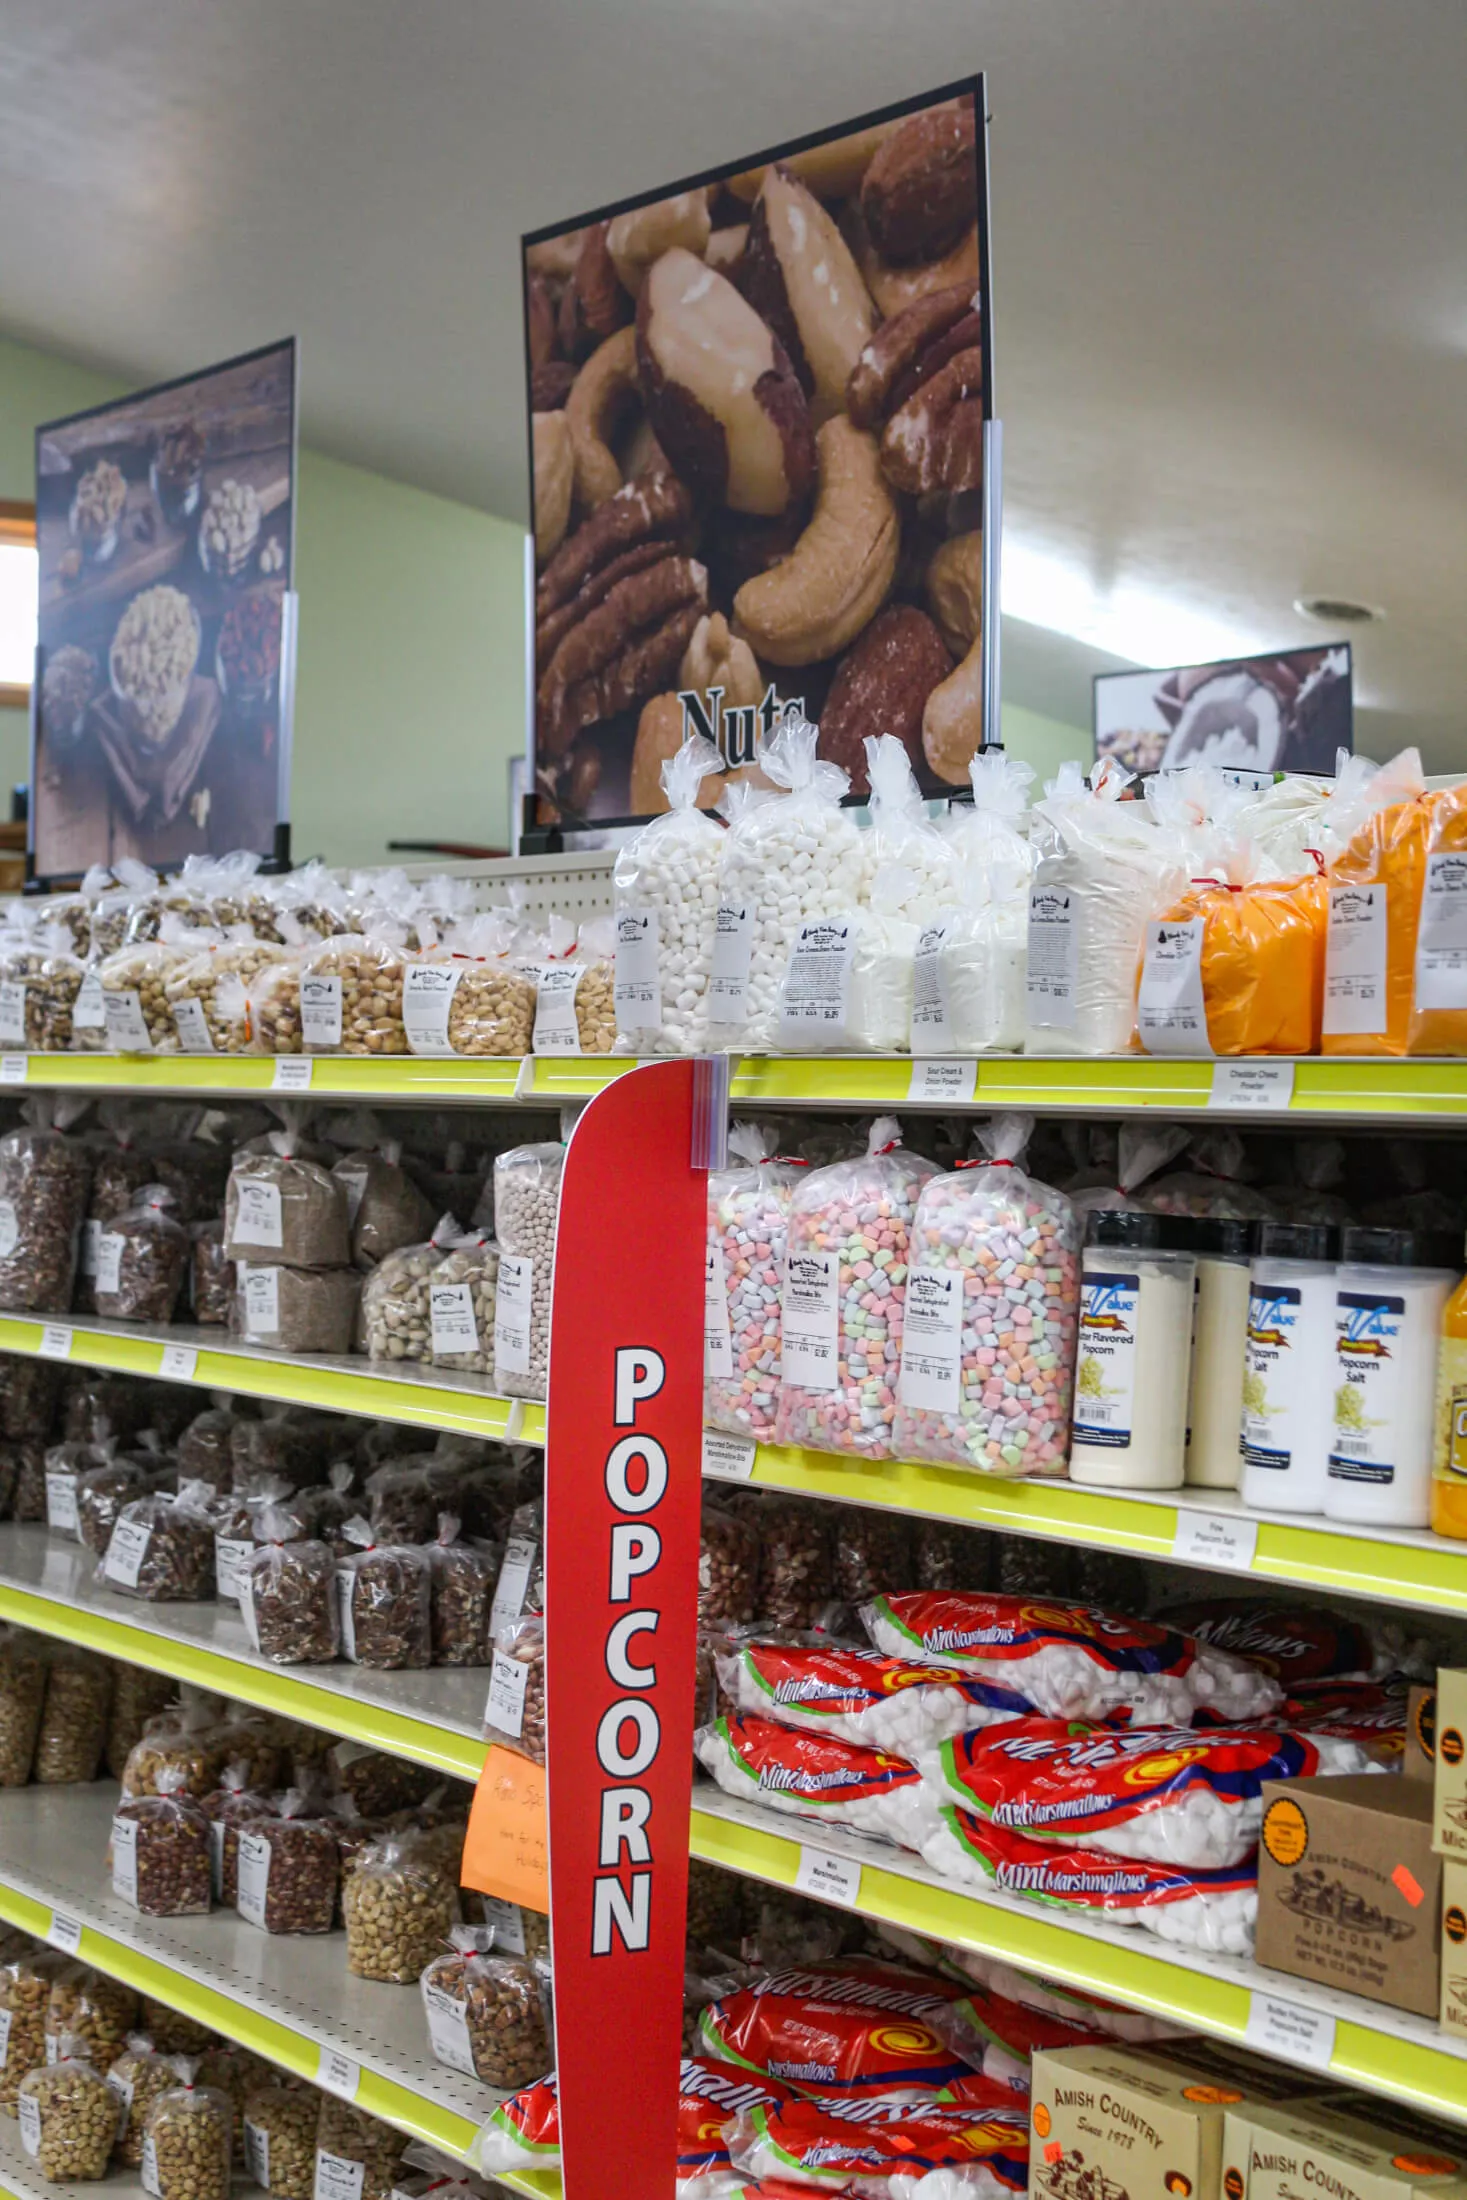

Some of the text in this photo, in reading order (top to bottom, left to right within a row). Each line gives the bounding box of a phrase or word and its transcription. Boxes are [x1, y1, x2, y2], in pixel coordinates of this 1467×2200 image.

[1082, 1344, 1115, 1355] Popcorn
[1092, 1332, 1134, 1344] Flavored
[1338, 1356, 1380, 1371] Popcorn
[1346, 1372, 1366, 1384] Salt
[590, 1345, 669, 1958] POPCORN
[996, 1859, 1148, 1894] Mini Marshmallows
[1303, 1919, 1383, 1952] POPCORN
[767, 2059, 838, 2082] Marshmallows
[1054, 2087, 1164, 2151] AMISH COUNTRY
[1252, 2150, 1362, 2200] AMISH COUNT
